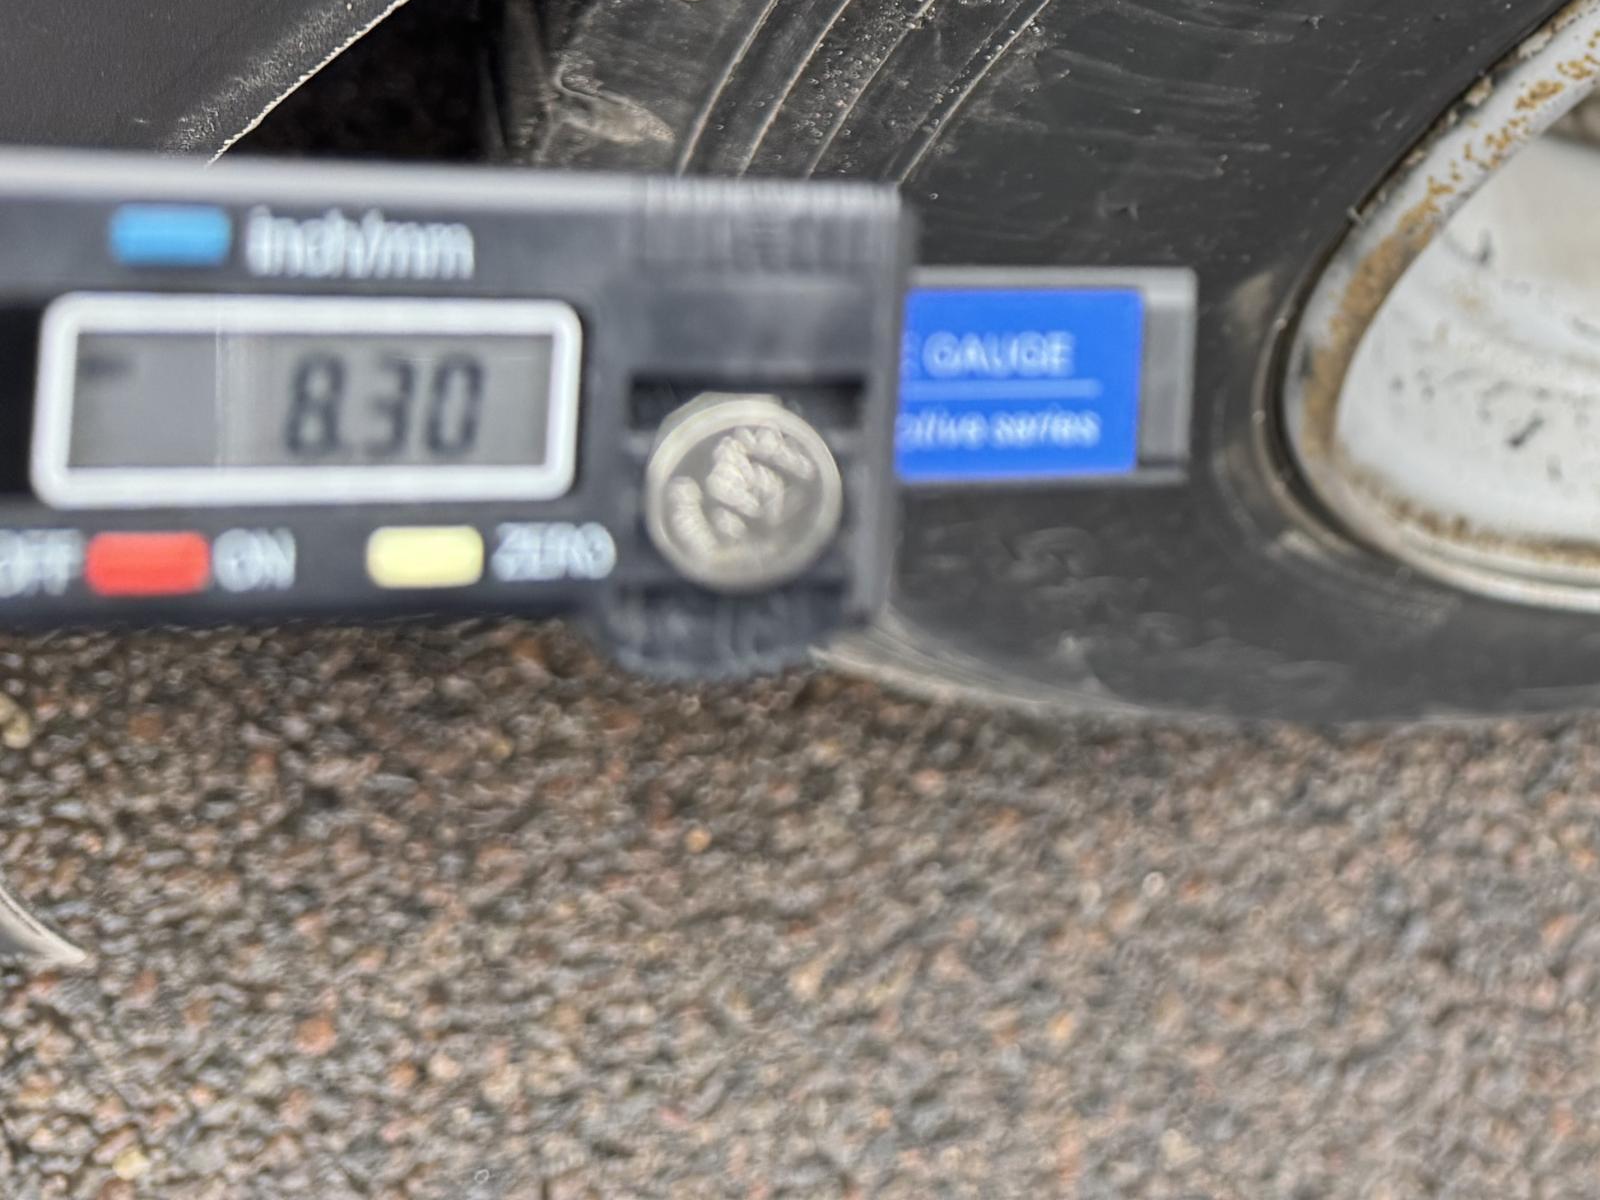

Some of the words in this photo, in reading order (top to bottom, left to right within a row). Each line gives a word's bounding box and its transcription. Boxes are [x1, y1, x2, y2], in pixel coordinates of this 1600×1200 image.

[922, 330, 1076, 379] GAUGE
[281, 348, 489, 460] 8.30
[989, 402, 1102, 451] series
[213, 527, 297, 593] ON
[491, 521, 618, 583] ZERO
